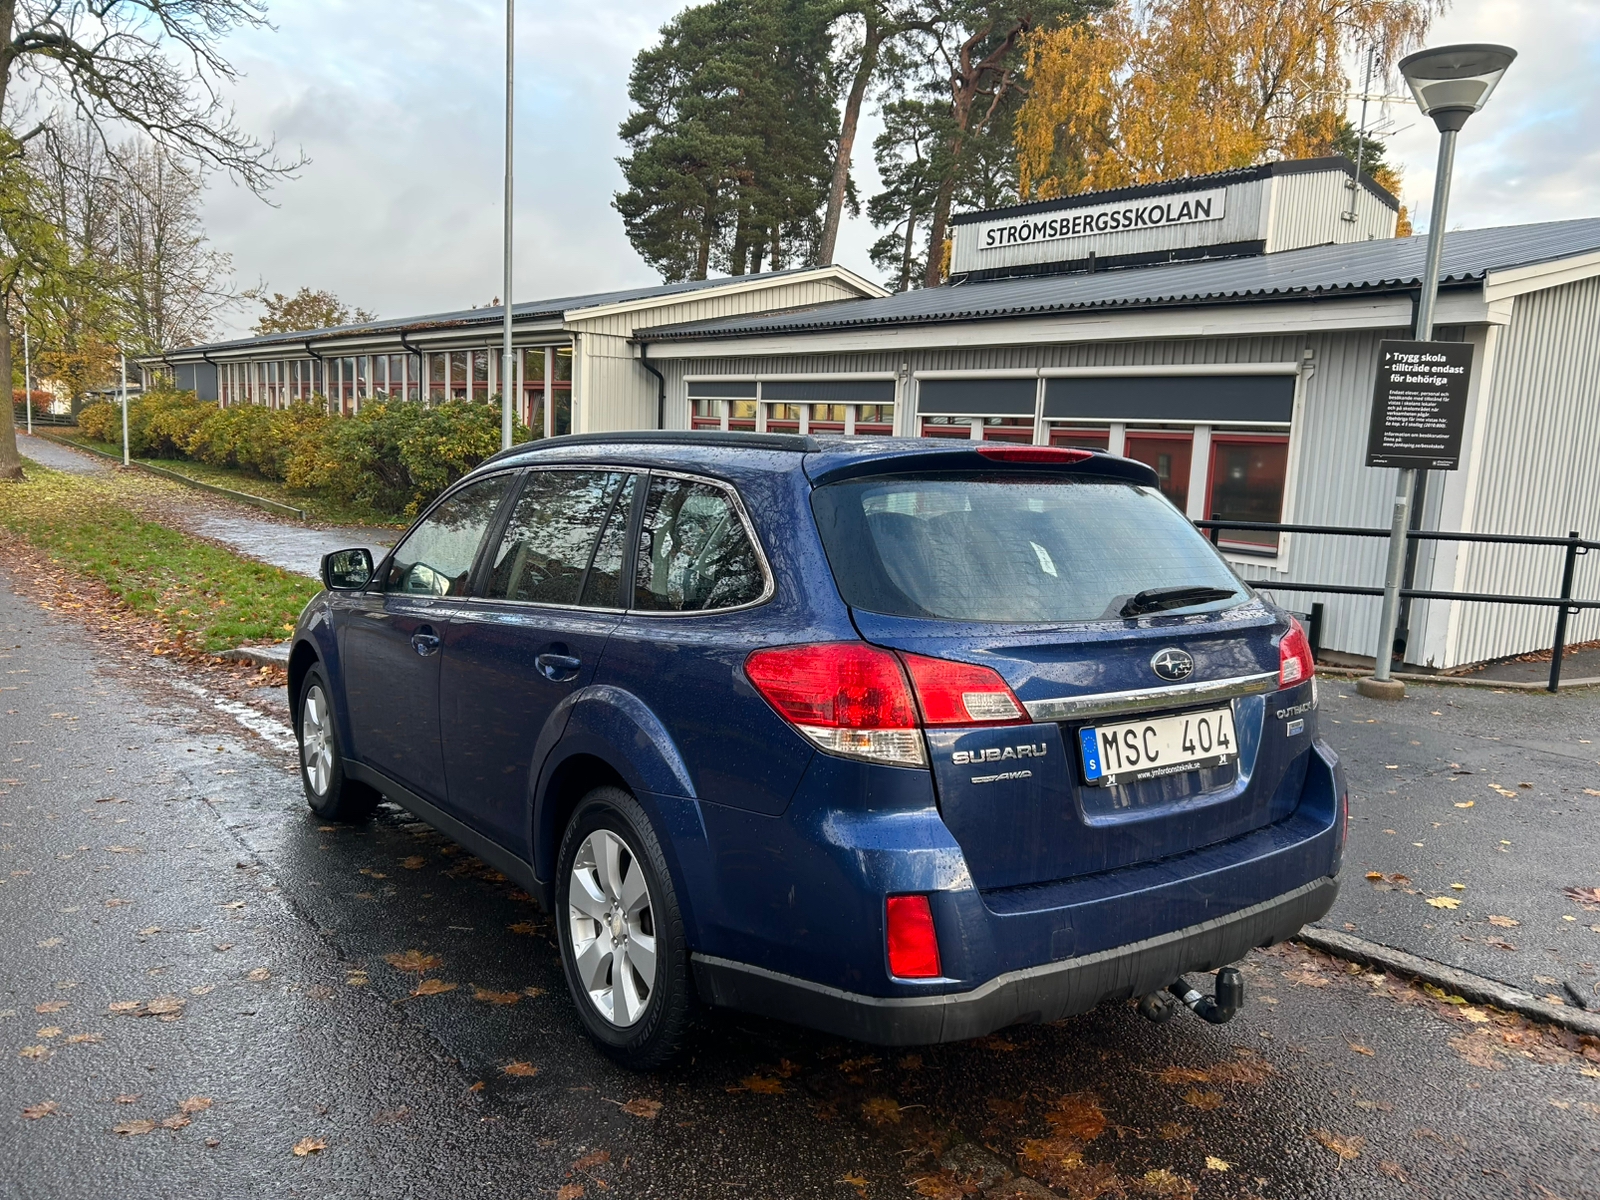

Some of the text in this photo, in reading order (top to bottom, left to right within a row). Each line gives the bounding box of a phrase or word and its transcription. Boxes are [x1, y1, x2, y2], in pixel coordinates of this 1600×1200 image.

[986, 198, 1212, 246] STRÖMSBERGSSKOLAN
[1393, 352, 1446, 362] Trygg skola
[1392, 364, 1430, 372] tillträde
[1431, 365, 1464, 374] endast
[1390, 374, 1447, 386] för behöriga
[1102, 715, 1230, 770] MSC 404
[952, 743, 1047, 765] SUBARU
[1090, 760, 1096, 770] S
